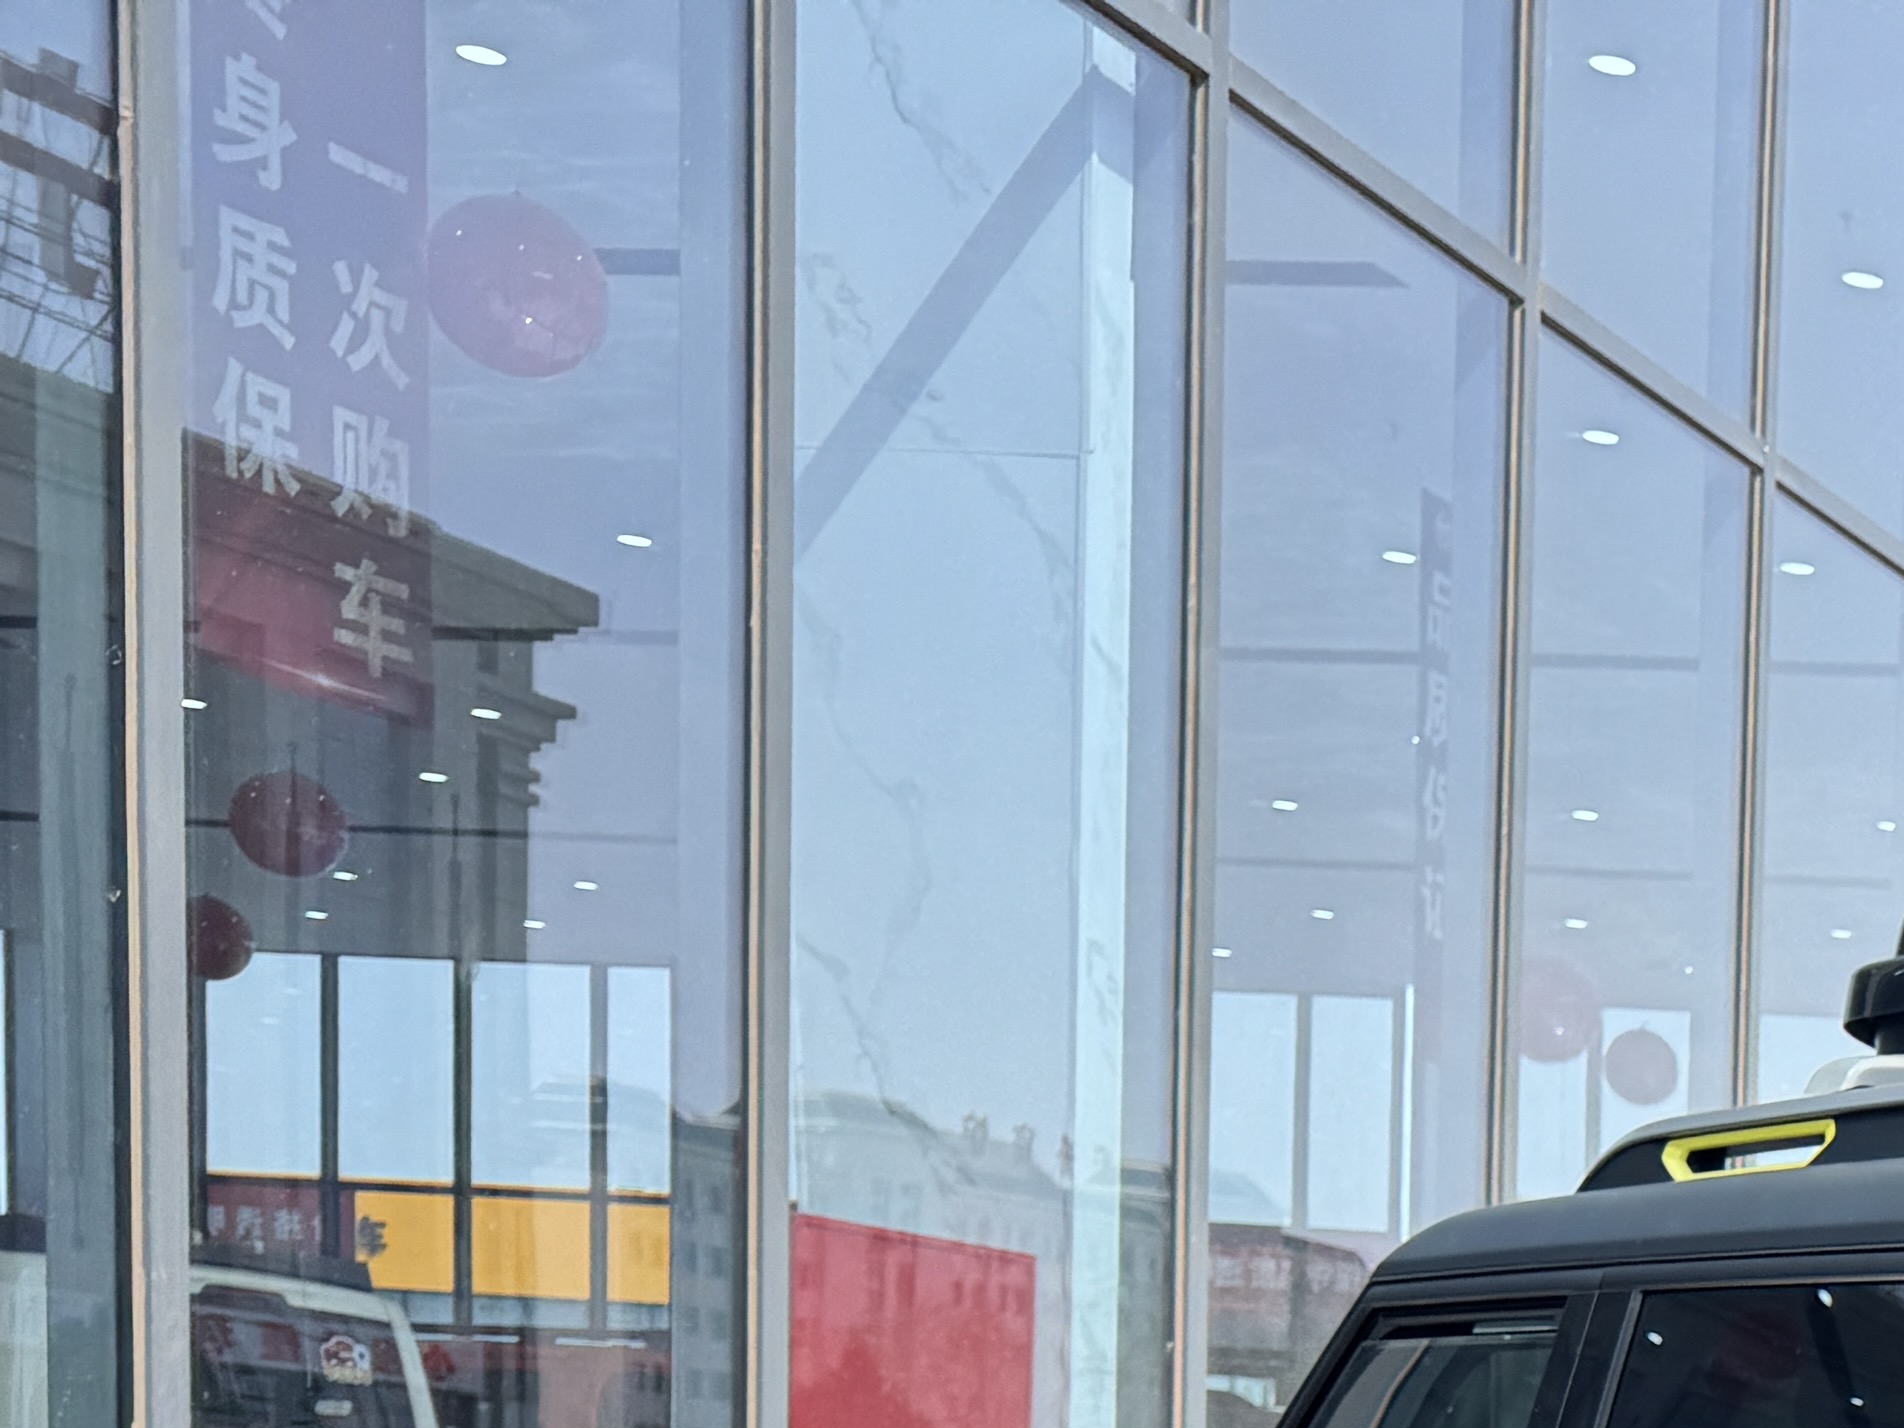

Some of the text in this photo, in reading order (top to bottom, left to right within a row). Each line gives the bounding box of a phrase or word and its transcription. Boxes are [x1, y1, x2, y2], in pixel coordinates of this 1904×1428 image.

[212, 0, 301, 498] 身质保
[328, 142, 415, 678] 一次购车
